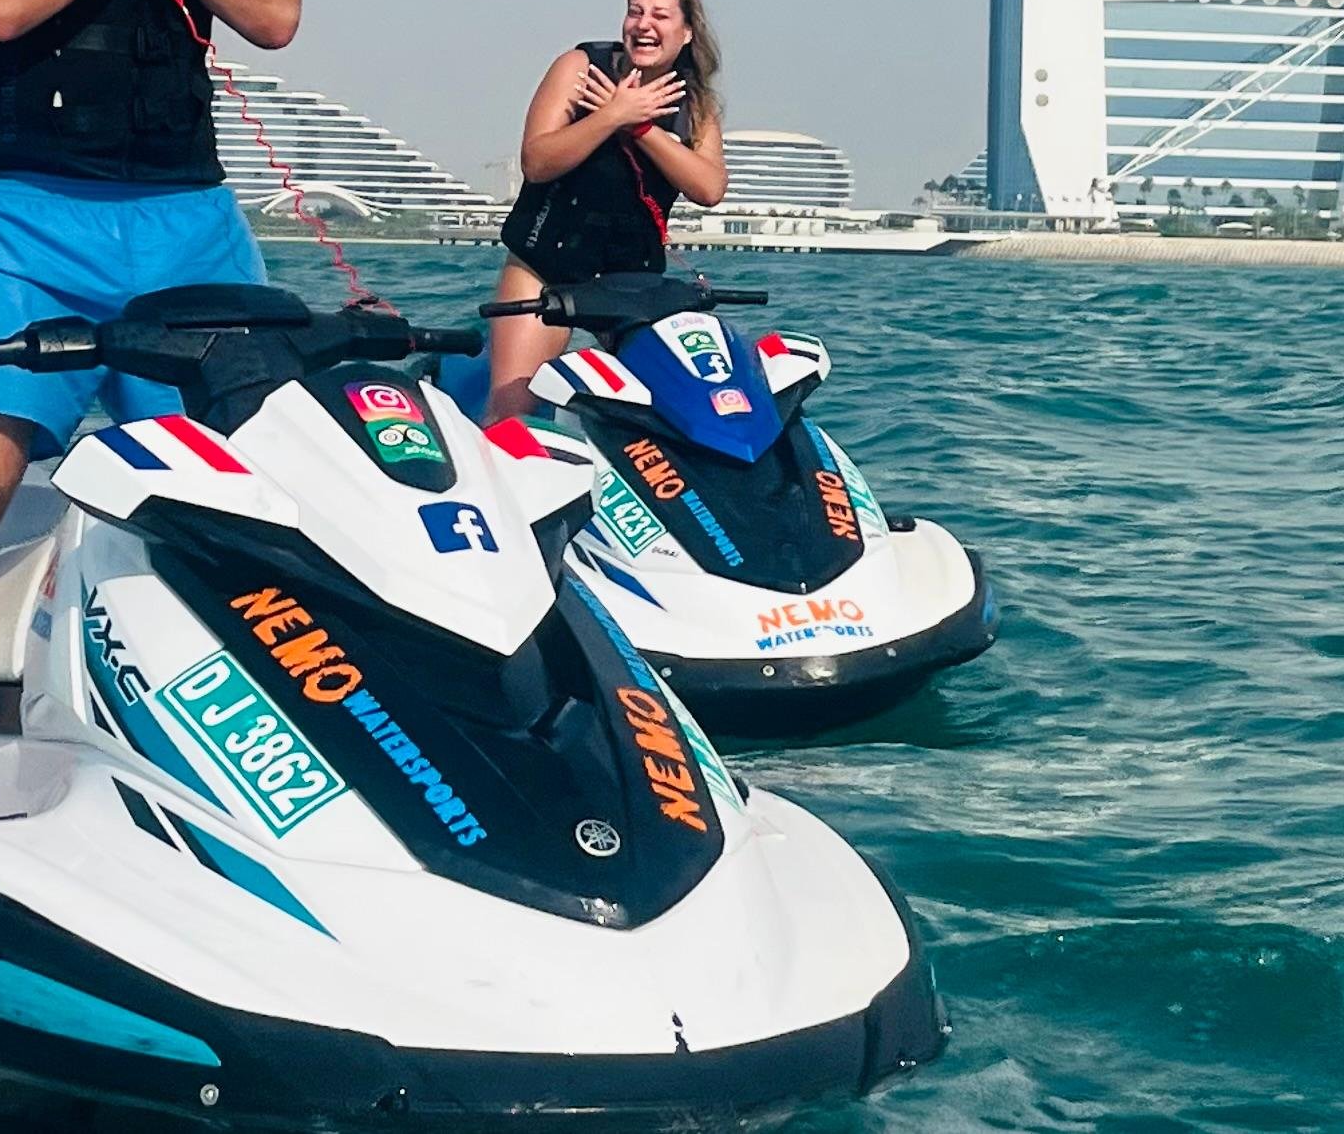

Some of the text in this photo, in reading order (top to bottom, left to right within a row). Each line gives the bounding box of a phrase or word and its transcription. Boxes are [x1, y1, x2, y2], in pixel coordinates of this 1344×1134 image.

[612, 500, 662, 547] 4231
[623, 437, 744, 567] NEMO WATERSPORTS
[815, 470, 859, 541] NEMO
[756, 625, 874, 651] WATERORTS
[757, 599, 865, 634] NEMO
[229, 587, 487, 847] NEMO WATERSPORTS
[616, 686, 708, 833] NEMO
[224, 714, 328, 816] 3862
